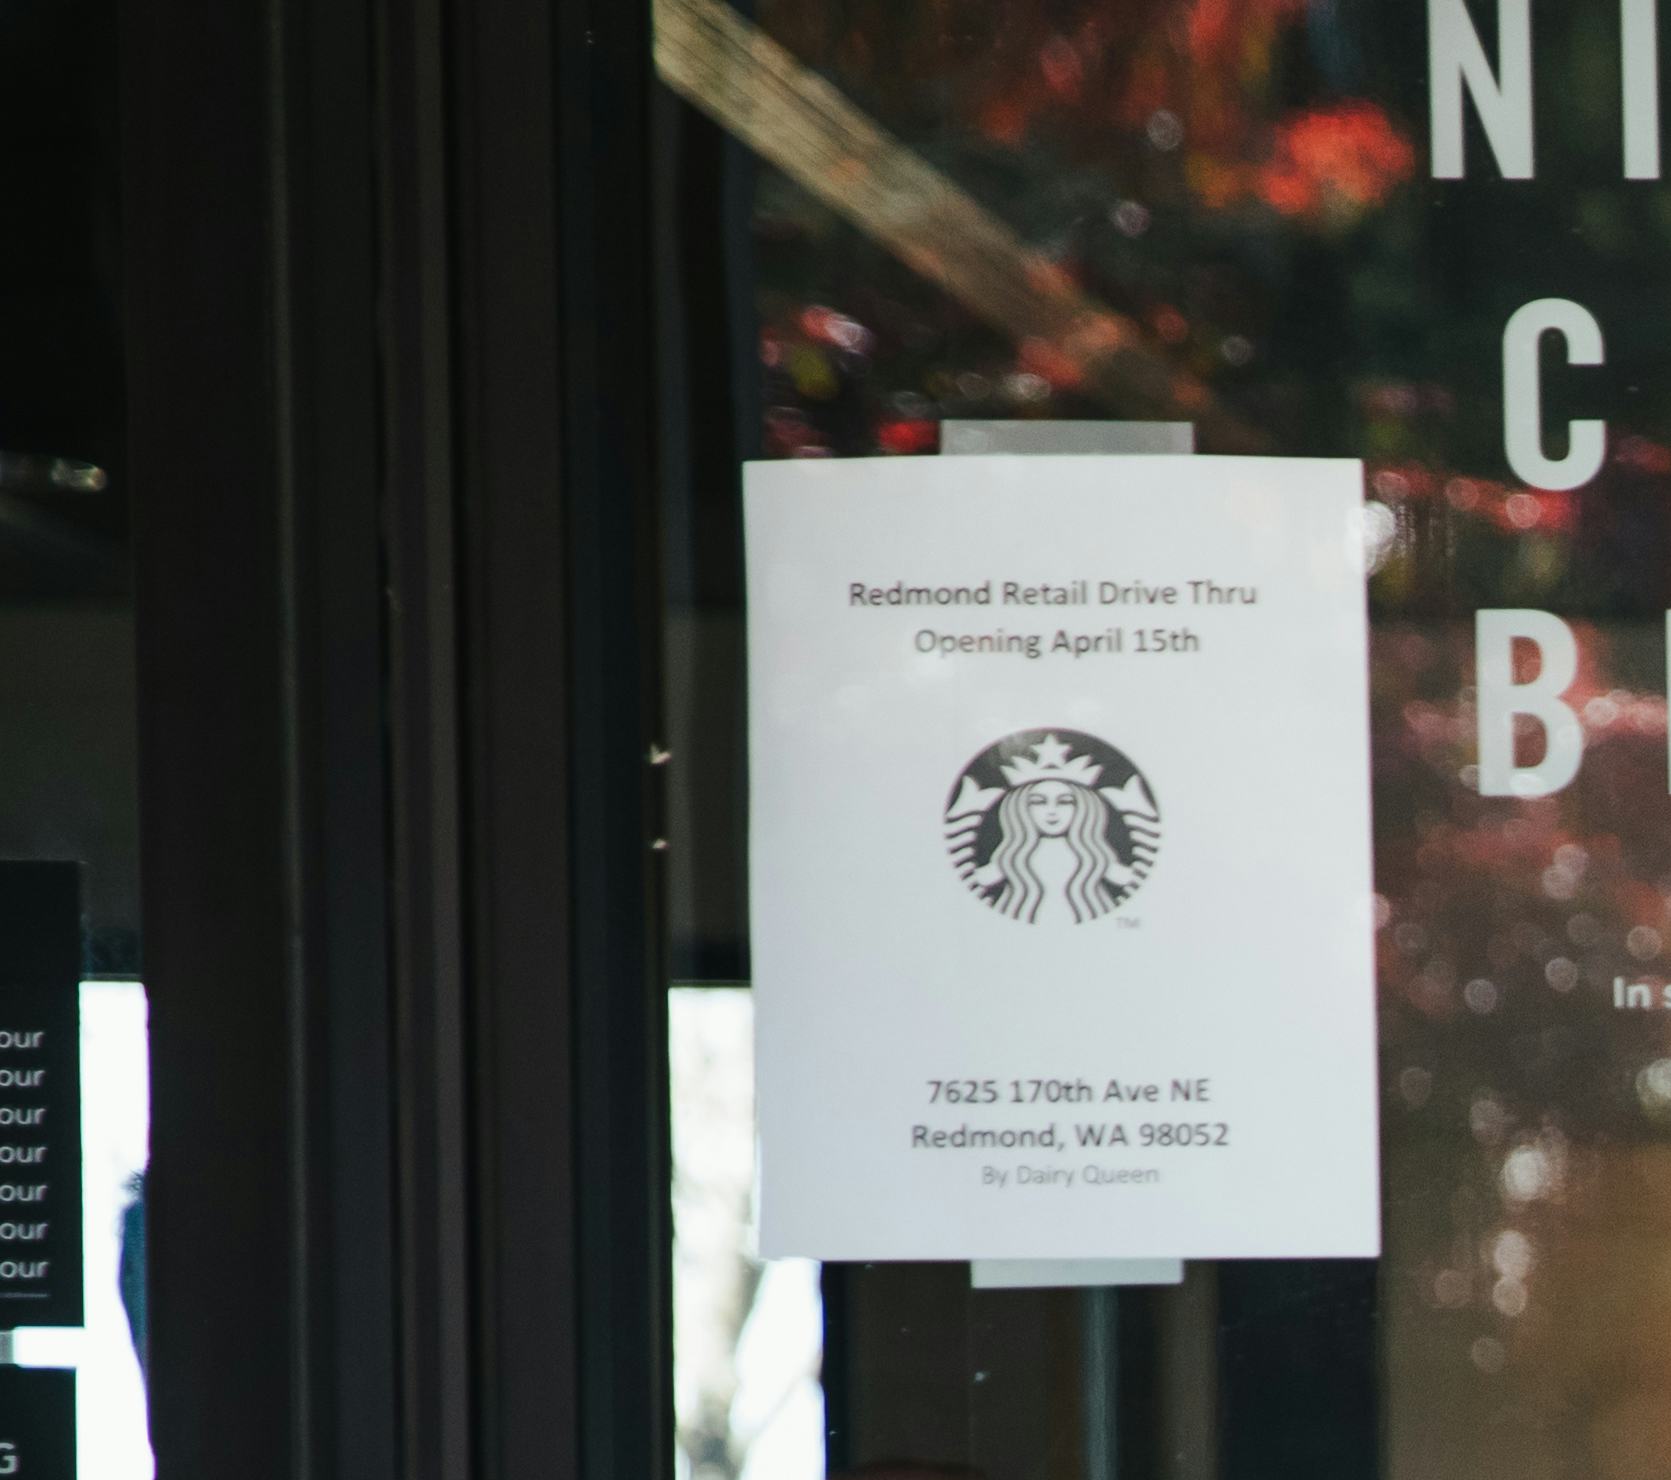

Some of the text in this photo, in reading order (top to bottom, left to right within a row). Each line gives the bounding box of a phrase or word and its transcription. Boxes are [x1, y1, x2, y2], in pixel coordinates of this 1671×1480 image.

[850, 580, 1257, 606] Redmond Retail Drive Thru
[914, 628, 1199, 658] Opening April 15th
[1613, 978, 1651, 1008] In
[927, 1078, 1210, 1105] 7625 170th Ave NE
[912, 1123, 1229, 1154] Redmond, WA 98052
[982, 1165, 1159, 1191] By Dairy Queen
